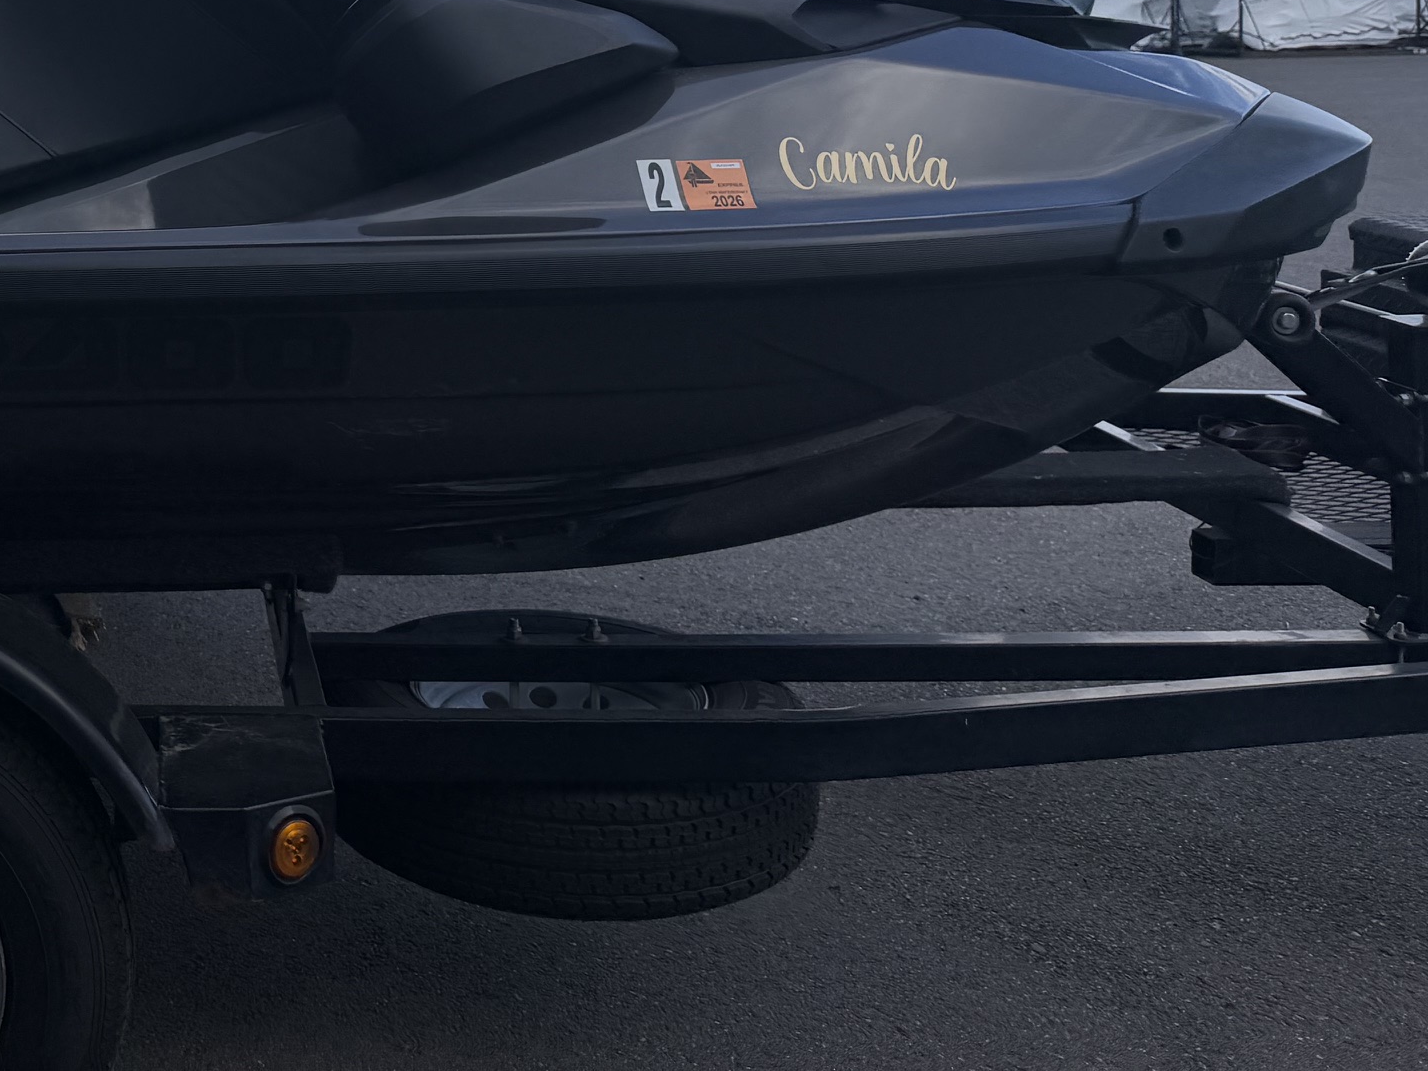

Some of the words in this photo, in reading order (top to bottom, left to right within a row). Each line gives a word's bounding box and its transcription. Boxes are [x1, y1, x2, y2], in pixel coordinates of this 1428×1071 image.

[648, 161, 673, 208] 2
[778, 133, 957, 191] Camila
[711, 194, 745, 207] 2026
